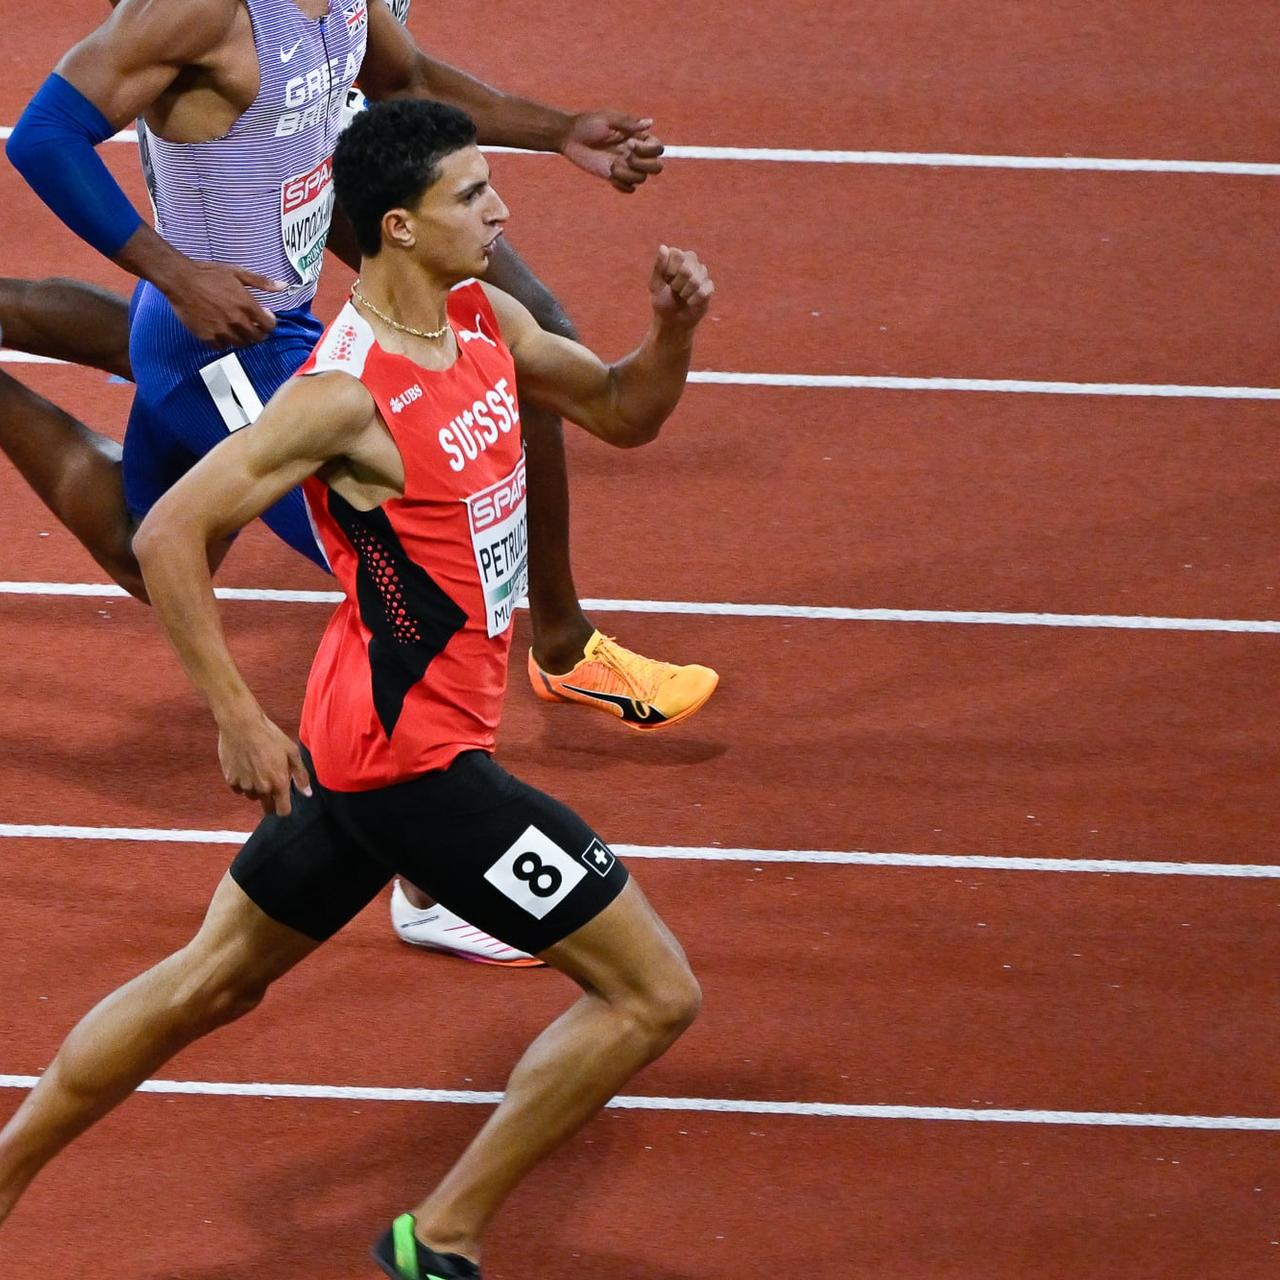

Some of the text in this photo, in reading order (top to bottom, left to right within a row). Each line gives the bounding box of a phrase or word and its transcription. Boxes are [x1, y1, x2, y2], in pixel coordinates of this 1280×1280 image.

[285, 163, 333, 209] SPA
[400, 384, 423, 407] UBS
[438, 378, 519, 472] SUISSE
[512, 851, 562, 898] 8
